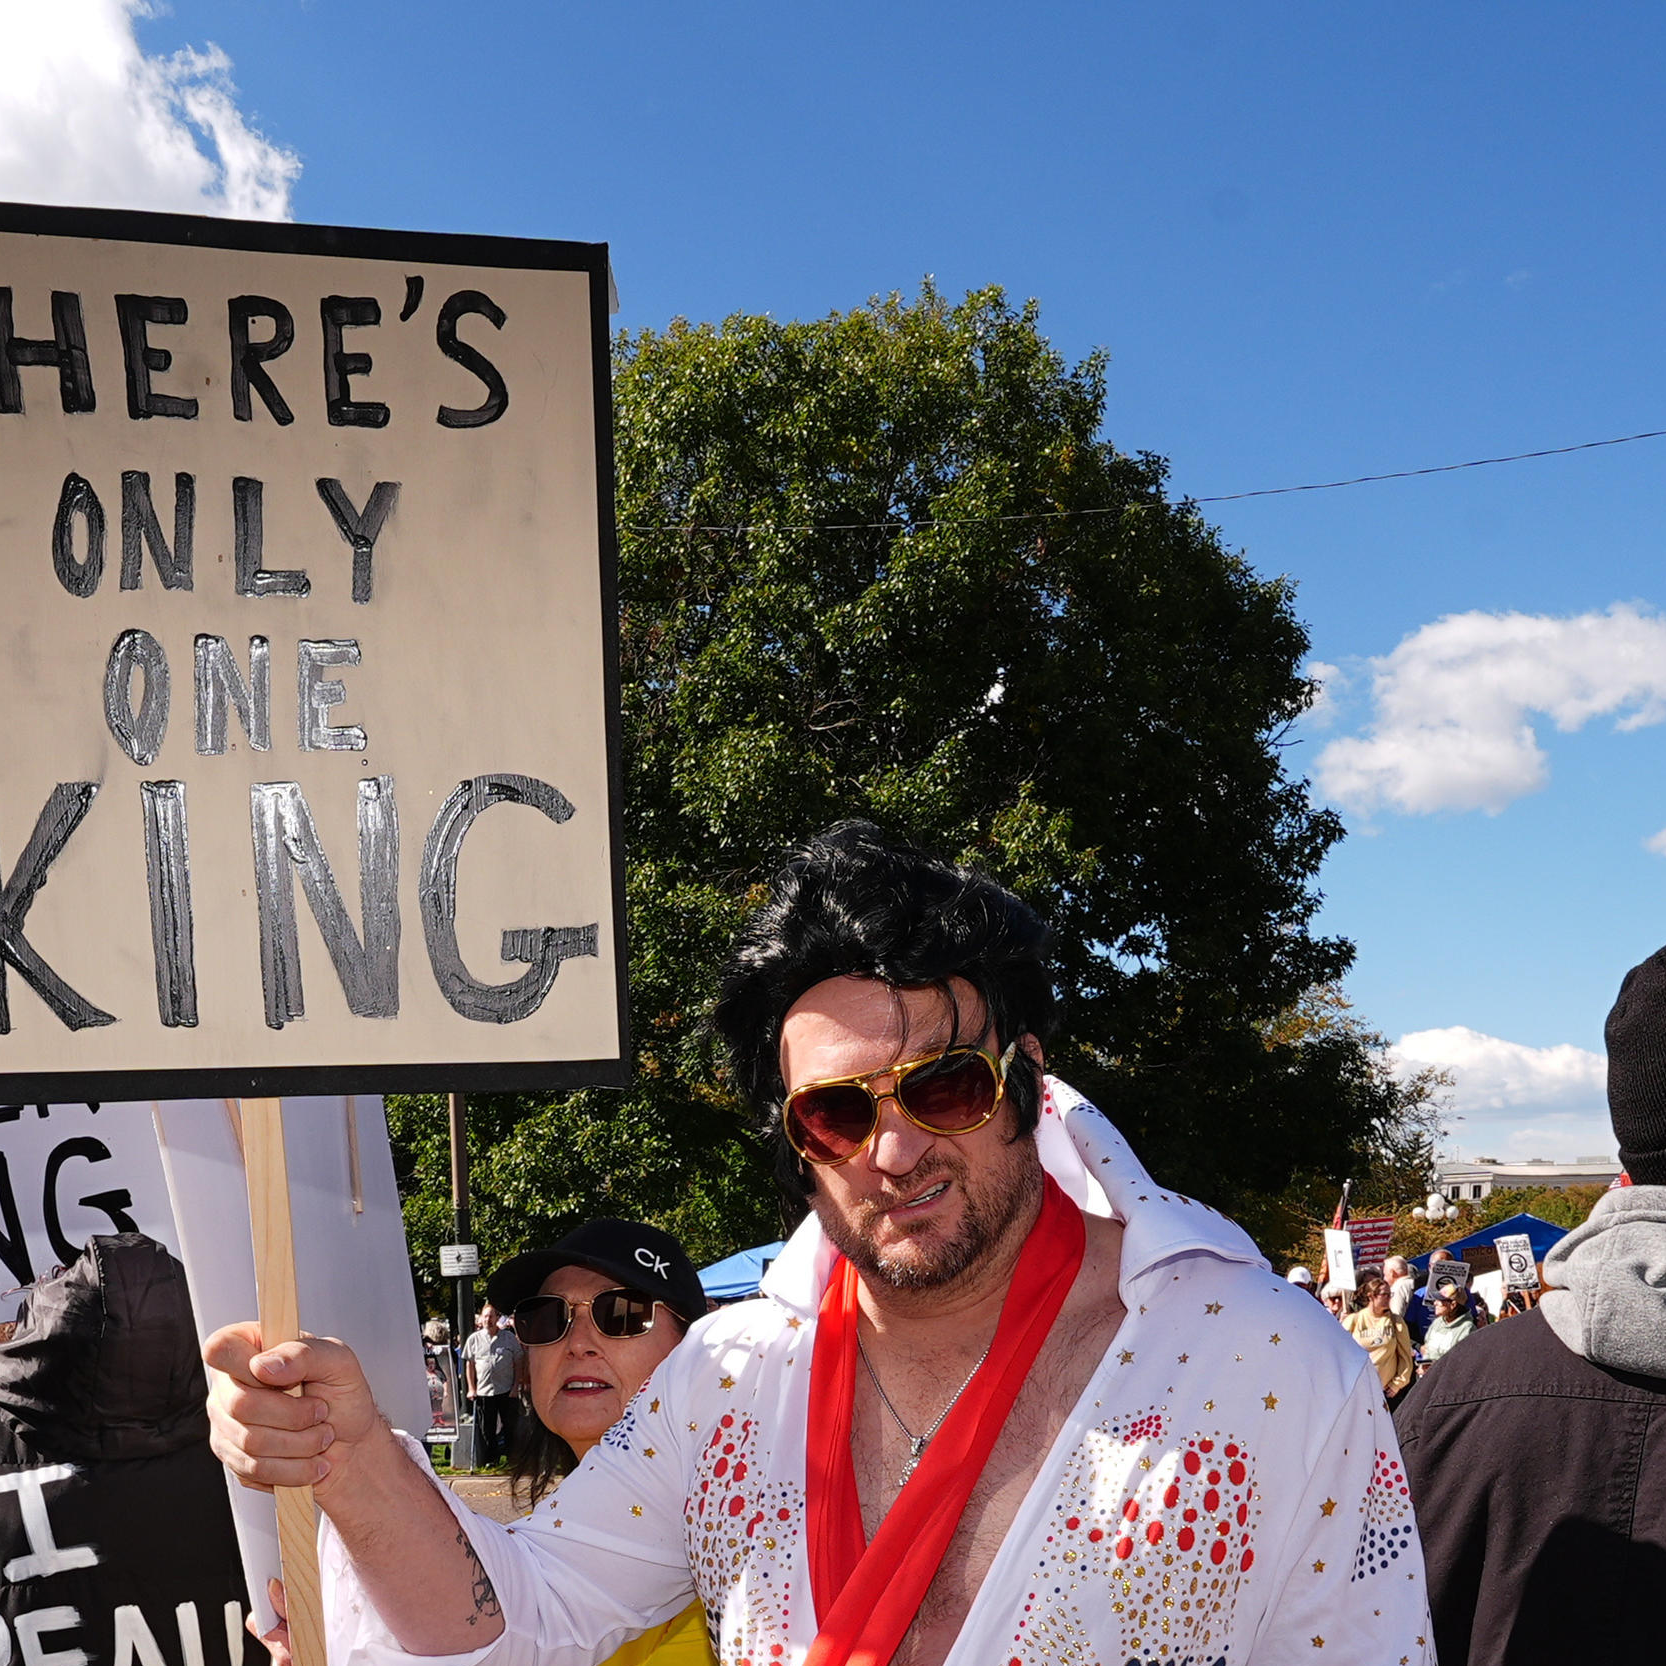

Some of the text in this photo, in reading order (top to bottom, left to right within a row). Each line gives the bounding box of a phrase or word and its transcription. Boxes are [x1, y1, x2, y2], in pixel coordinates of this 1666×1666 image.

[51, 470, 401, 604] ONLY
[103, 628, 369, 766] ONE
[634, 1247, 670, 1280] CK
